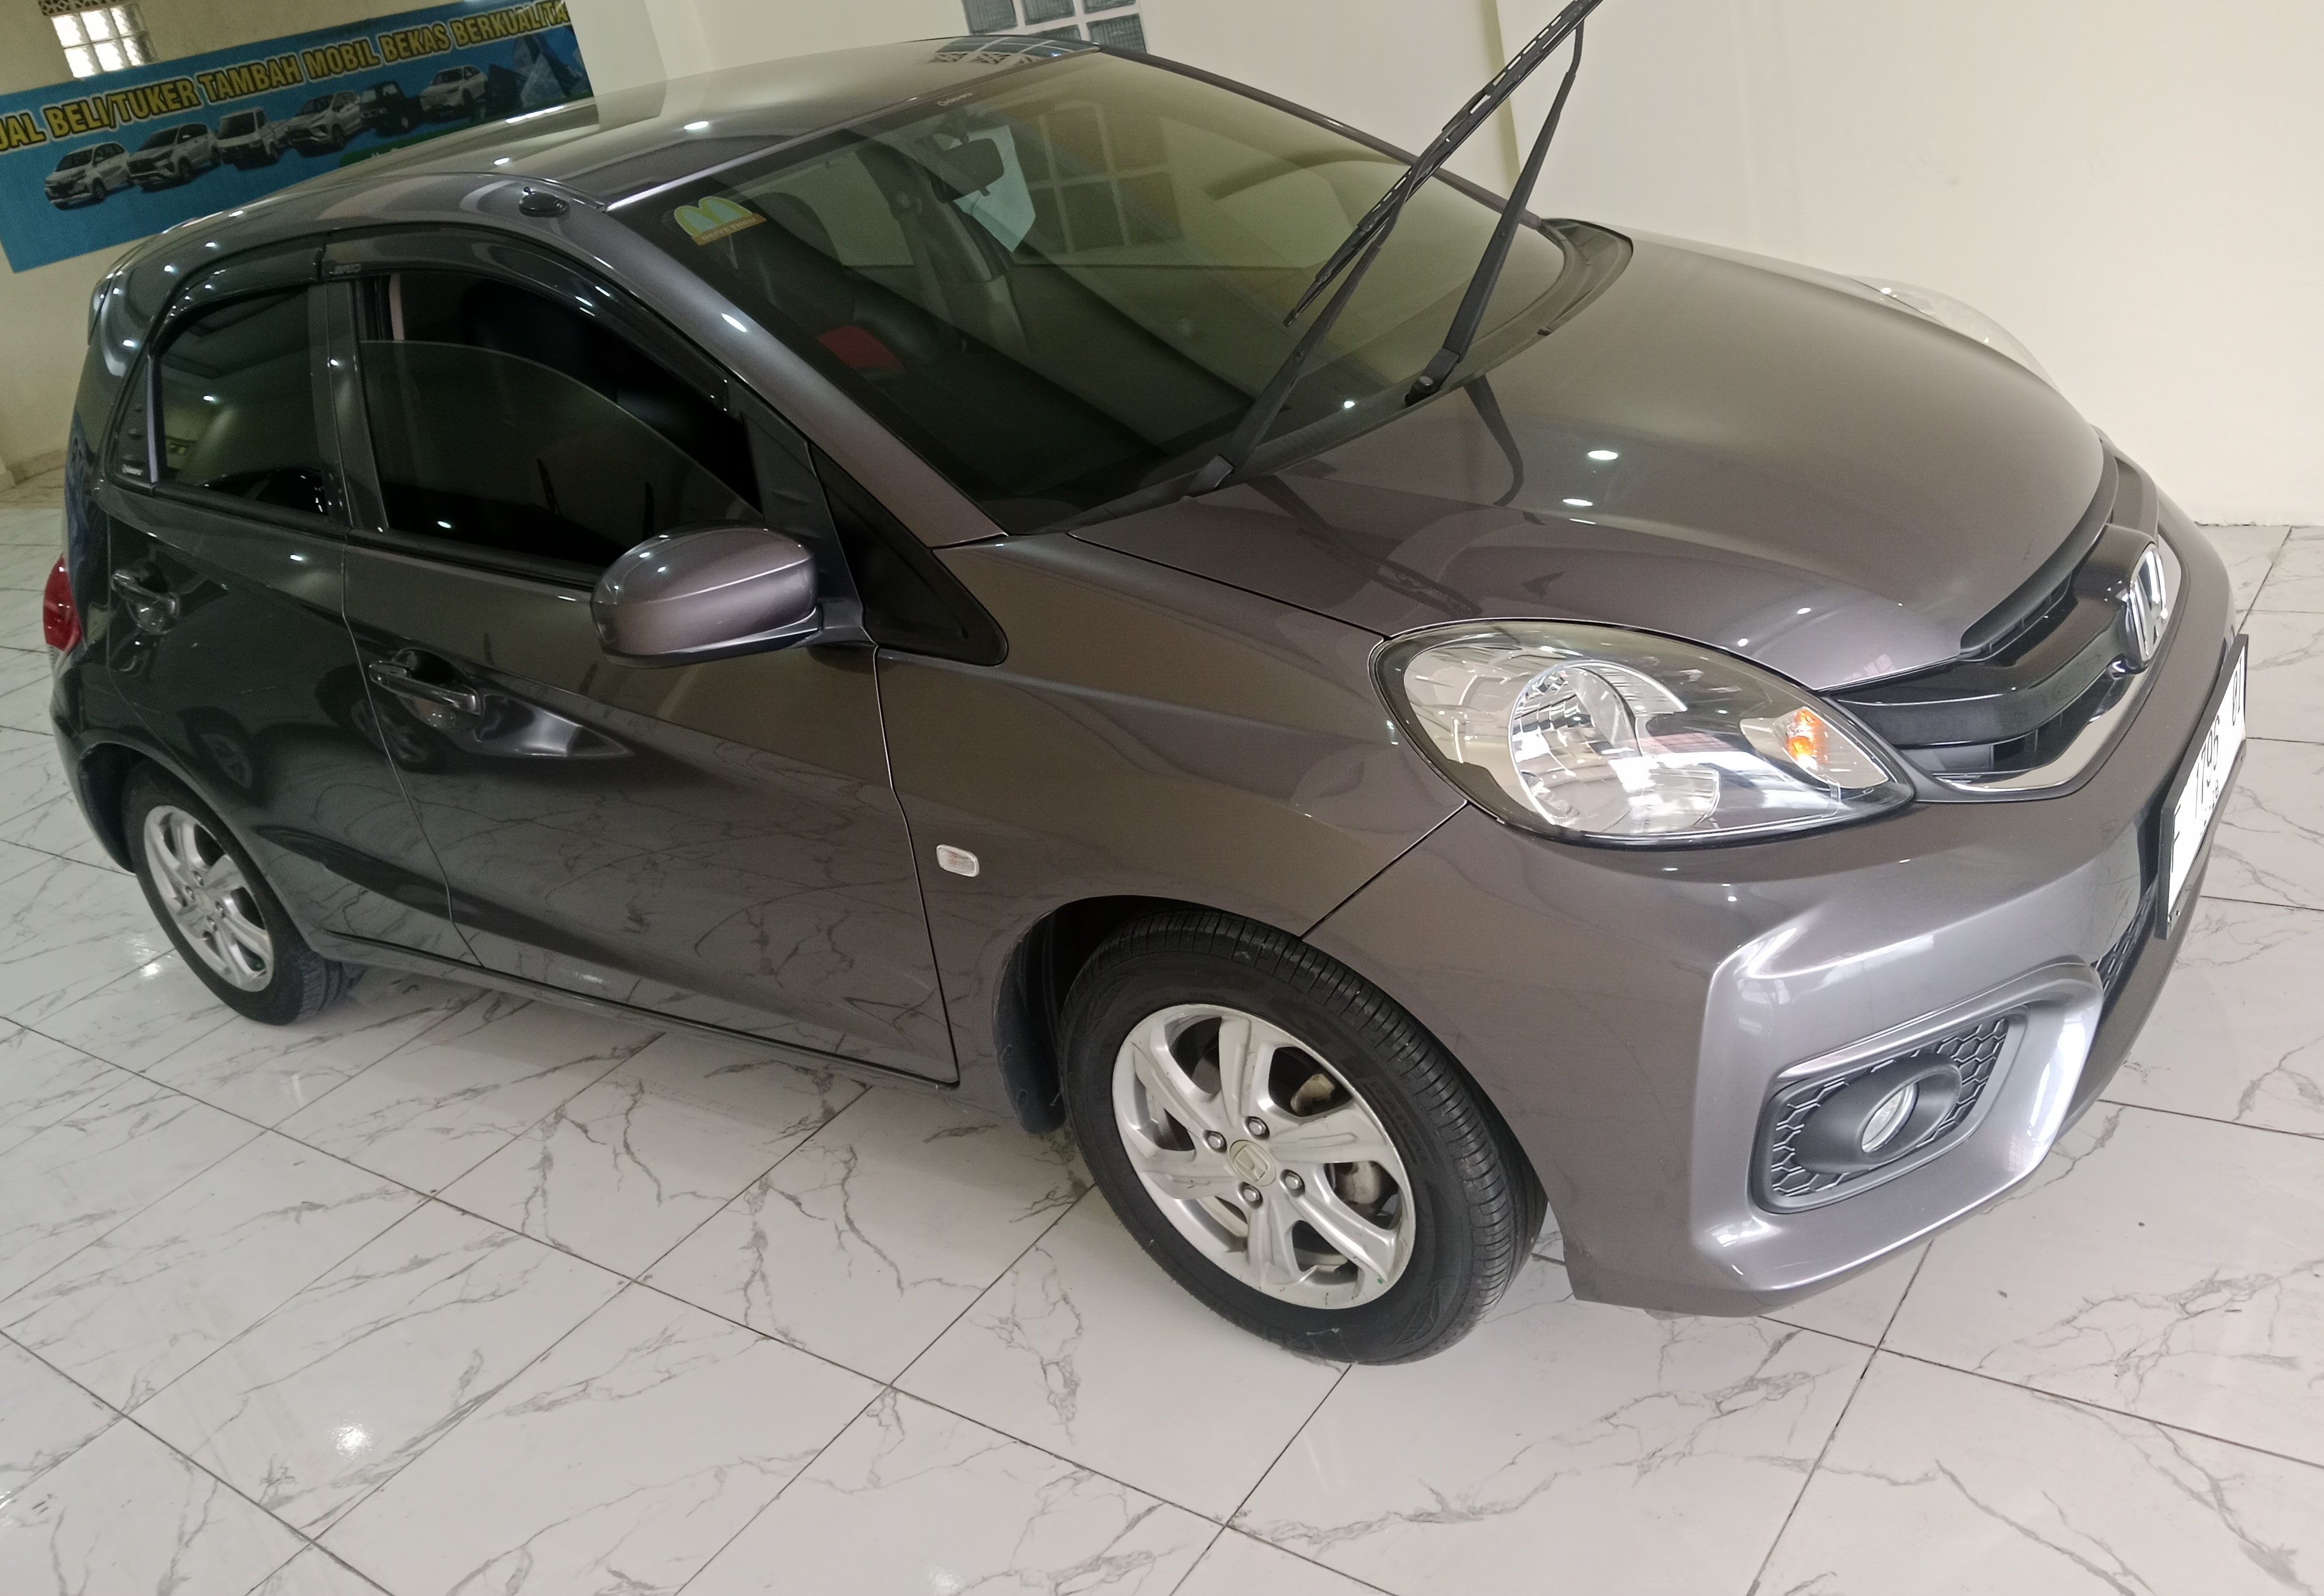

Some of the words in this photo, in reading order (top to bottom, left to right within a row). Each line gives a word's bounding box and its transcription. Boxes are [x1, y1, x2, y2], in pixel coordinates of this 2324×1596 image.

[42, 78, 202, 138] BELI/TUKER
[196, 54, 303, 103] TAMBAH
[301, 39, 380, 80] MOBIL
[377, 23, 452, 63] BEKAS
[2195, 715, 2221, 820] 1796
